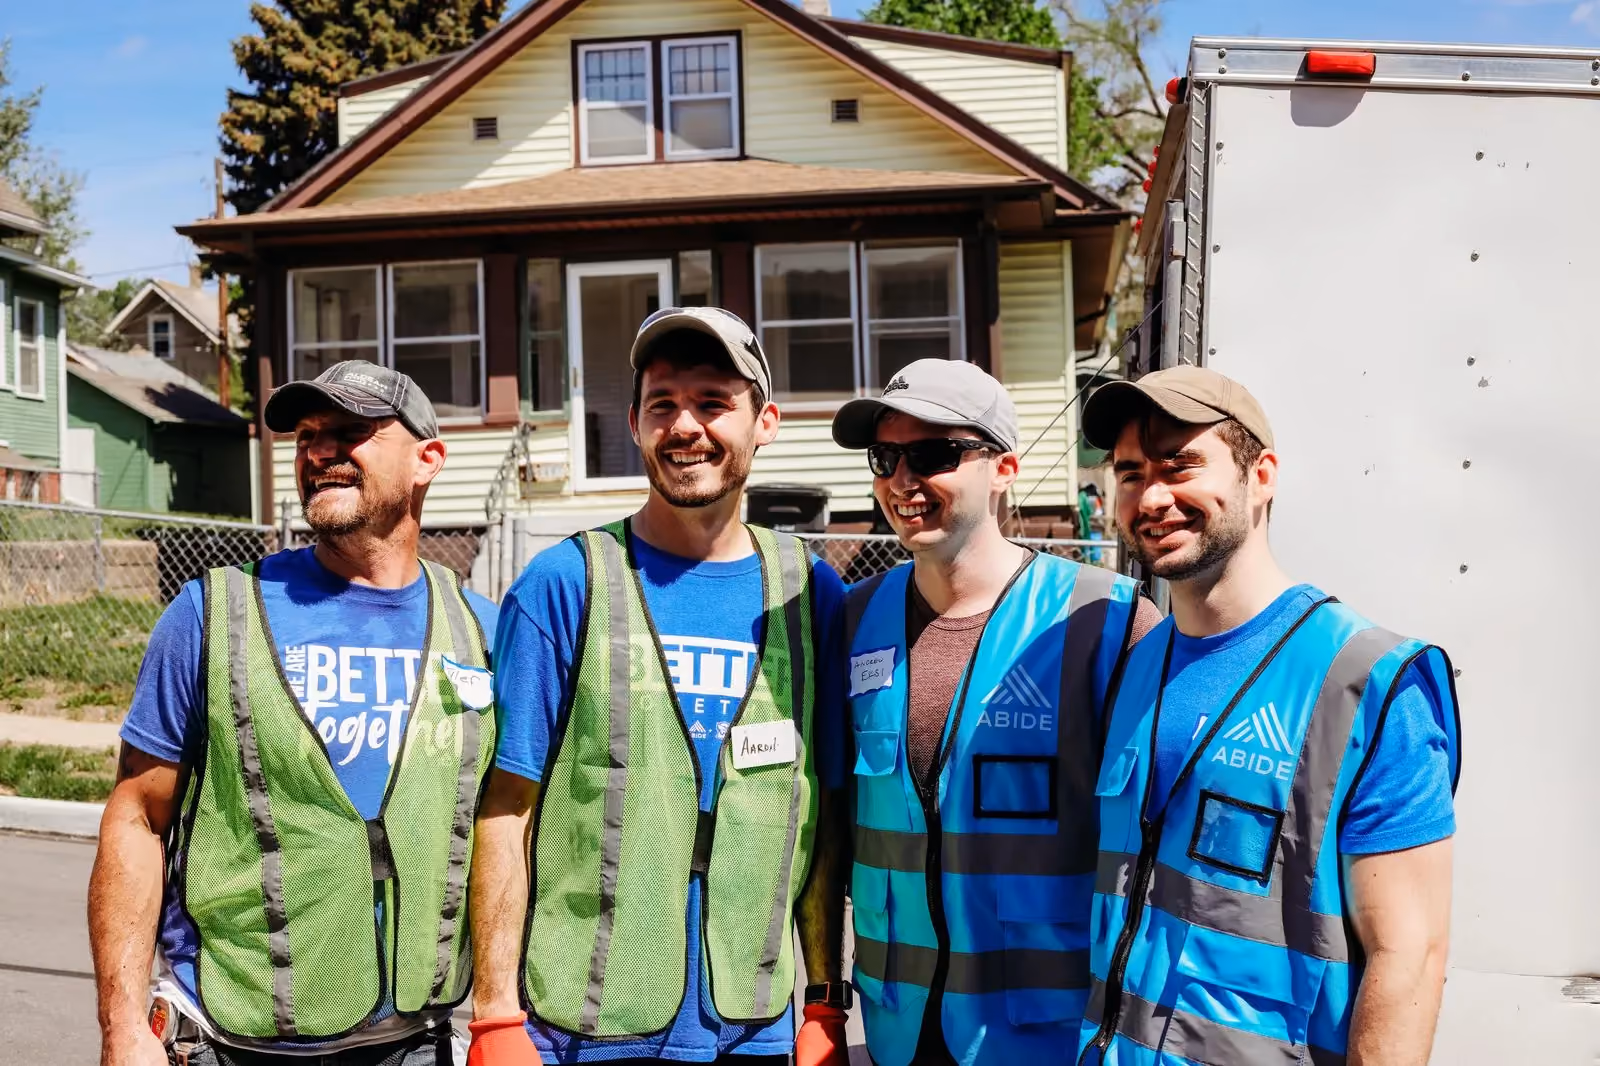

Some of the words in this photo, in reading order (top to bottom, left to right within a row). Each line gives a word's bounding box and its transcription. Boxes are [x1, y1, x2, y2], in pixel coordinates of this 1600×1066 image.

[285, 644, 305, 673] ARE
[976, 710, 1053, 731] ABIDE
[1211, 746, 1293, 781] ABIDE
